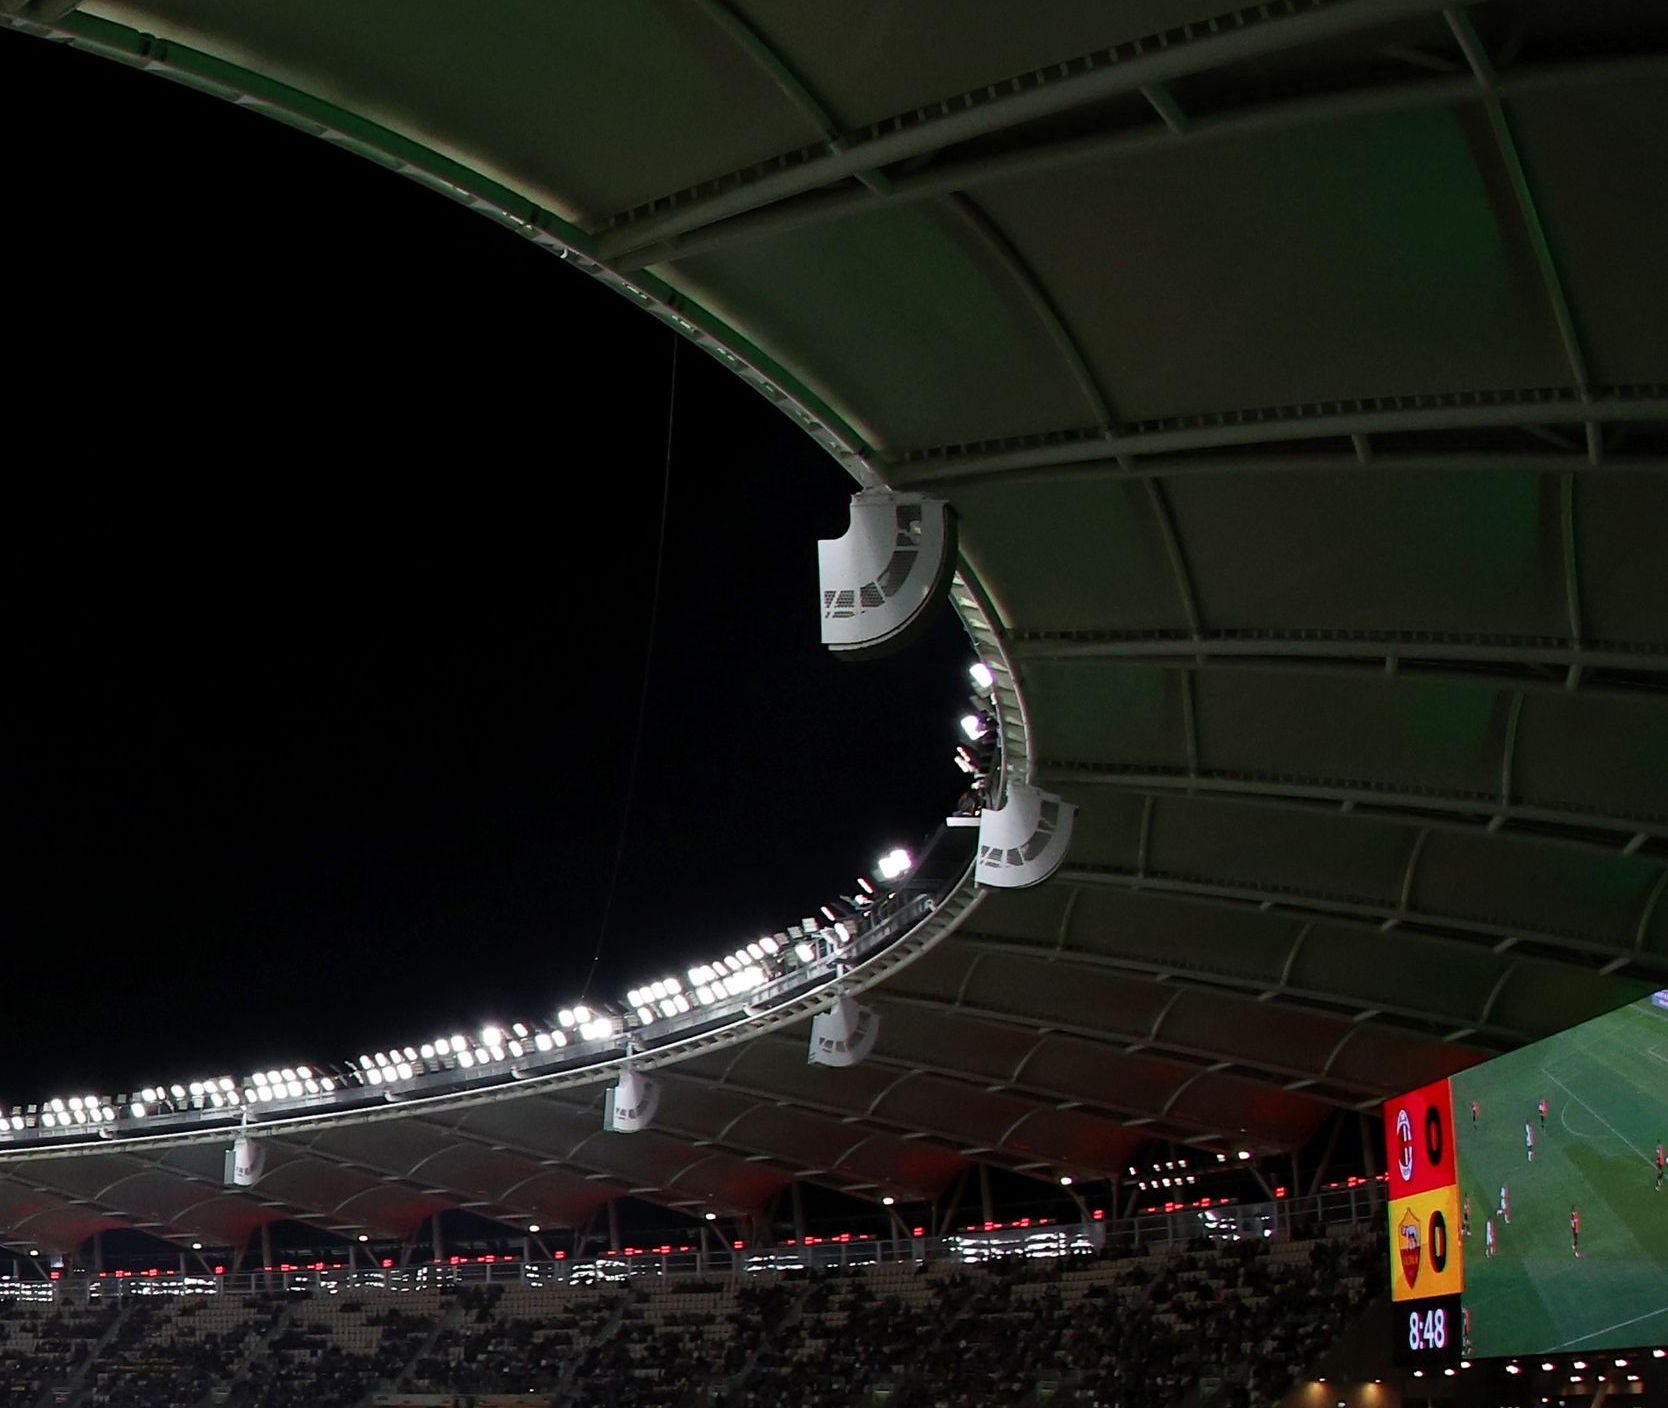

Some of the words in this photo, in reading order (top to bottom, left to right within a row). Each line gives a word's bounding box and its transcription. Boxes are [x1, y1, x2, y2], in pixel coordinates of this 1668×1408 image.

[1426, 1104, 1443, 1167] 0
[1428, 1210, 1447, 1273] 0
[1409, 1308, 1447, 1350] 8:48
